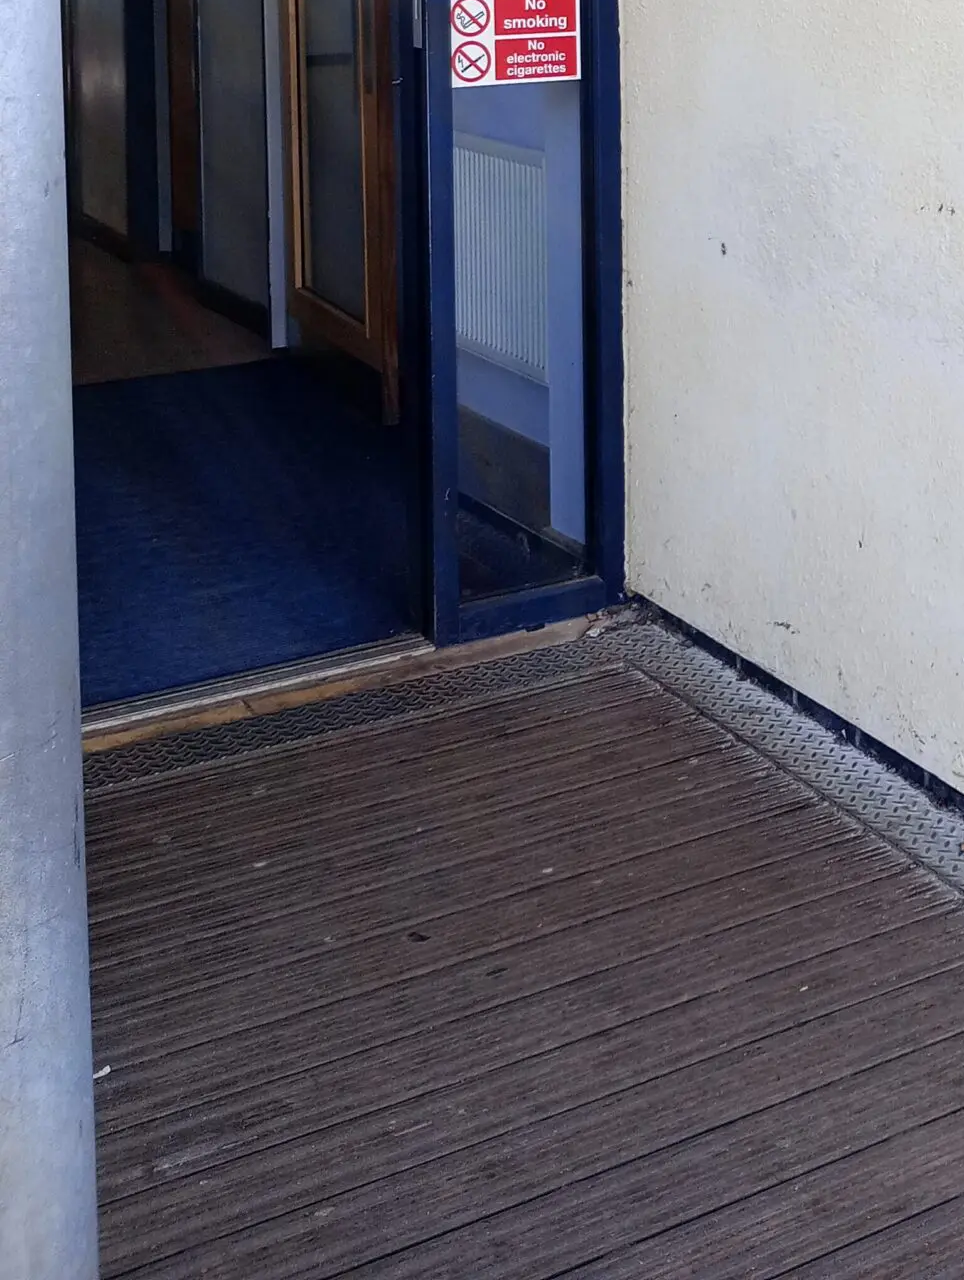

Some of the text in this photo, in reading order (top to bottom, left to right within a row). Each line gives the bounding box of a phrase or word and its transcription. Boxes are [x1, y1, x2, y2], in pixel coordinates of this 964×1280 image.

[503, 14, 567, 29] smoking
[528, 39, 545, 51] No
[506, 51, 566, 64] electronic
[506, 63, 567, 77] cigarettes
